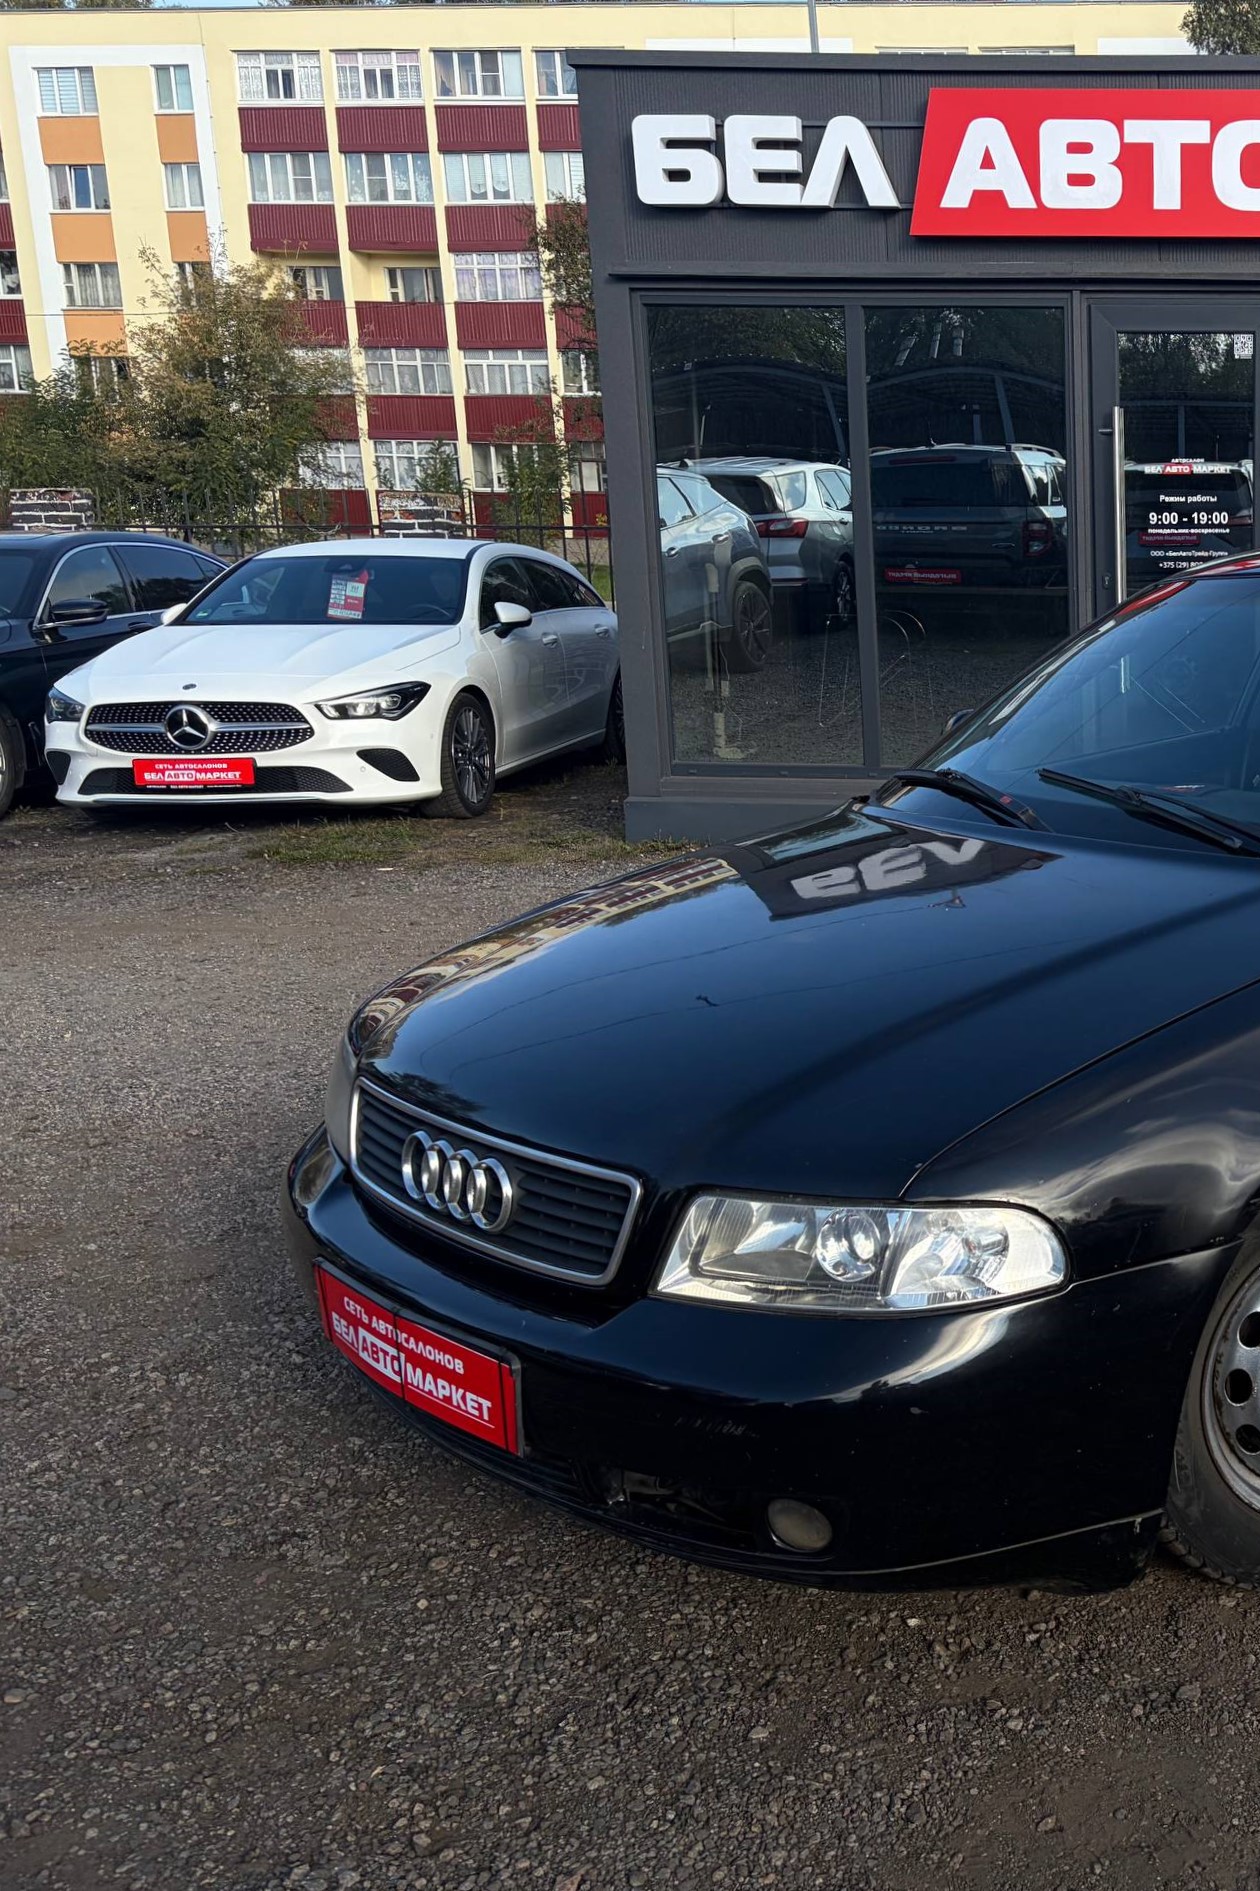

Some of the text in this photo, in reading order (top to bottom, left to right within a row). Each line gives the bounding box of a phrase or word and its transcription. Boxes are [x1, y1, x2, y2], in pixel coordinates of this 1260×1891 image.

[631, 114, 900, 210] БЕЛ
[1165, 465, 1190, 473] АВТО
[1193, 465, 1231, 473] МАРКЕТ
[1187, 495, 1217, 504] работы
[1149, 512, 1178, 525] 9:00
[1191, 512, 1229, 525] 19:00
[1159, 561, 1175, 569] +375
[1176, 561, 1189, 569] (29)
[144, 772, 163, 780] БЕЛ
[195, 771, 241, 780] МАРКЕТ
[343, 1296, 465, 1375] СЕТЬ АВТОСАЛОНОВ
[331, 1312, 493, 1421] БЕЛ АВТО МАРКЕТ
